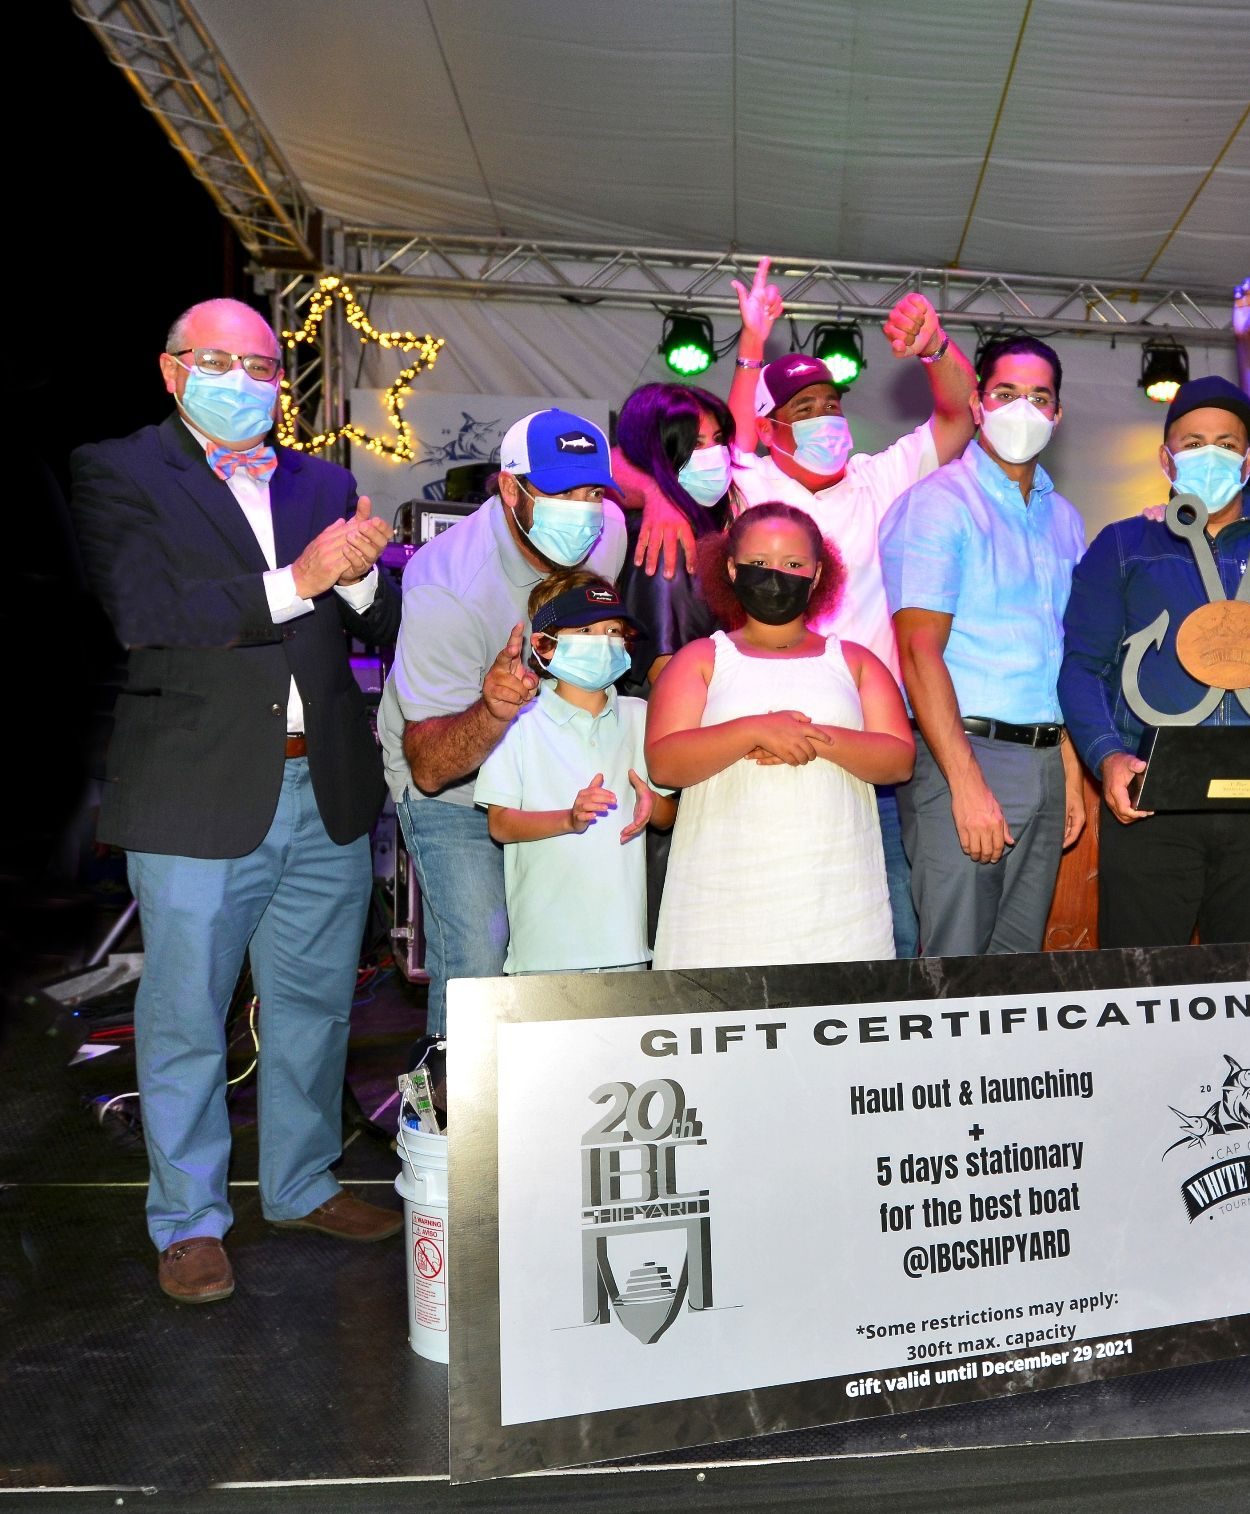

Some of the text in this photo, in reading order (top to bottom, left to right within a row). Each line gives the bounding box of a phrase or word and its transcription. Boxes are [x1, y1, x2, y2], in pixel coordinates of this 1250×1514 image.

[640, 1022, 787, 1058] GIFT
[850, 1068, 1094, 1116] Haul out & launching
[1200, 1084, 1212, 1094] 20
[968, 1123, 985, 1142] +
[1216, 1142, 1241, 1160] CAP
[581, 1138, 710, 1209] IBC
[876, 1141, 1084, 1187] 5 days stationary
[1187, 1161, 1248, 1208] WHITE
[416, 1217, 442, 1228] WARNING
[879, 1182, 1081, 1233] for the best boat
[903, 1228, 1071, 1279] @IBCSHIPYARD
[921, 1306, 1024, 1332] restrictions
[1028, 1300, 1065, 1317] may
[1069, 1291, 1119, 1314] apply:
[906, 1323, 1077, 1361] 300ft max. capacity
[845, 1338, 1133, 1398] Gift valid until December 29 2021
